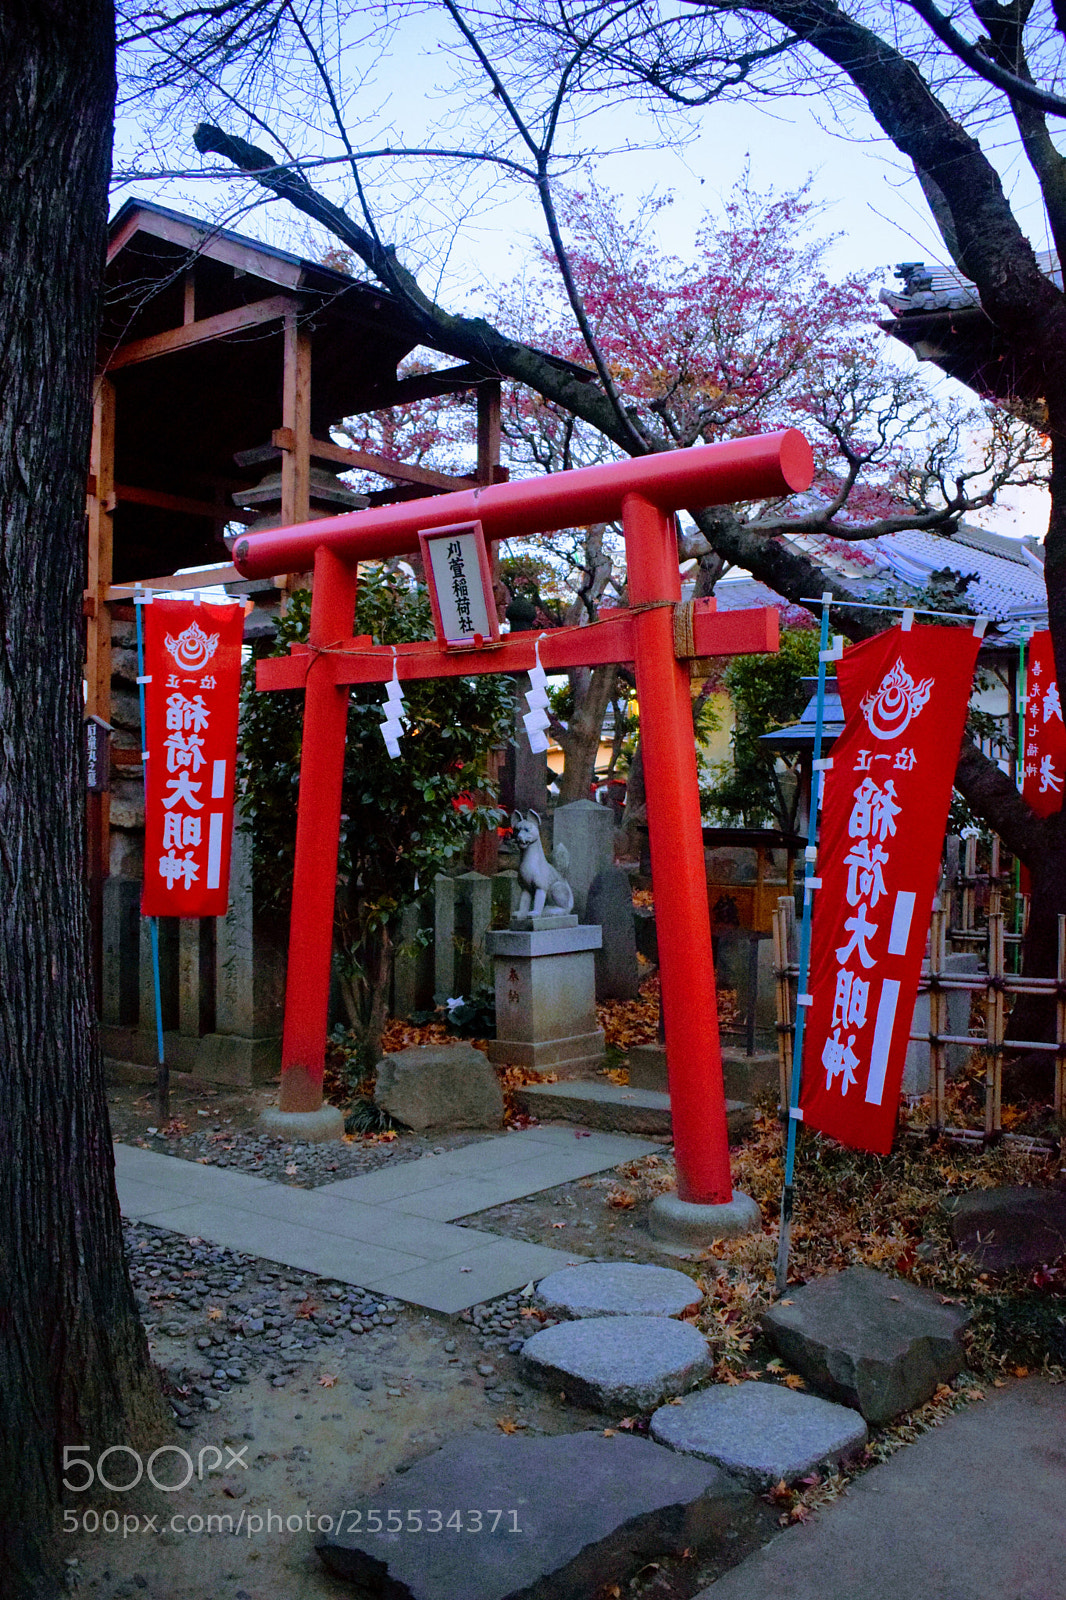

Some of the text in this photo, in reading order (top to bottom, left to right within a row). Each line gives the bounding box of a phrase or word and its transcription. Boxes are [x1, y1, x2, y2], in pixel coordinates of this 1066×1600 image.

[446, 540, 475, 634] 刈萱稲荷社
[508, 967, 520, 1004] 奉納
